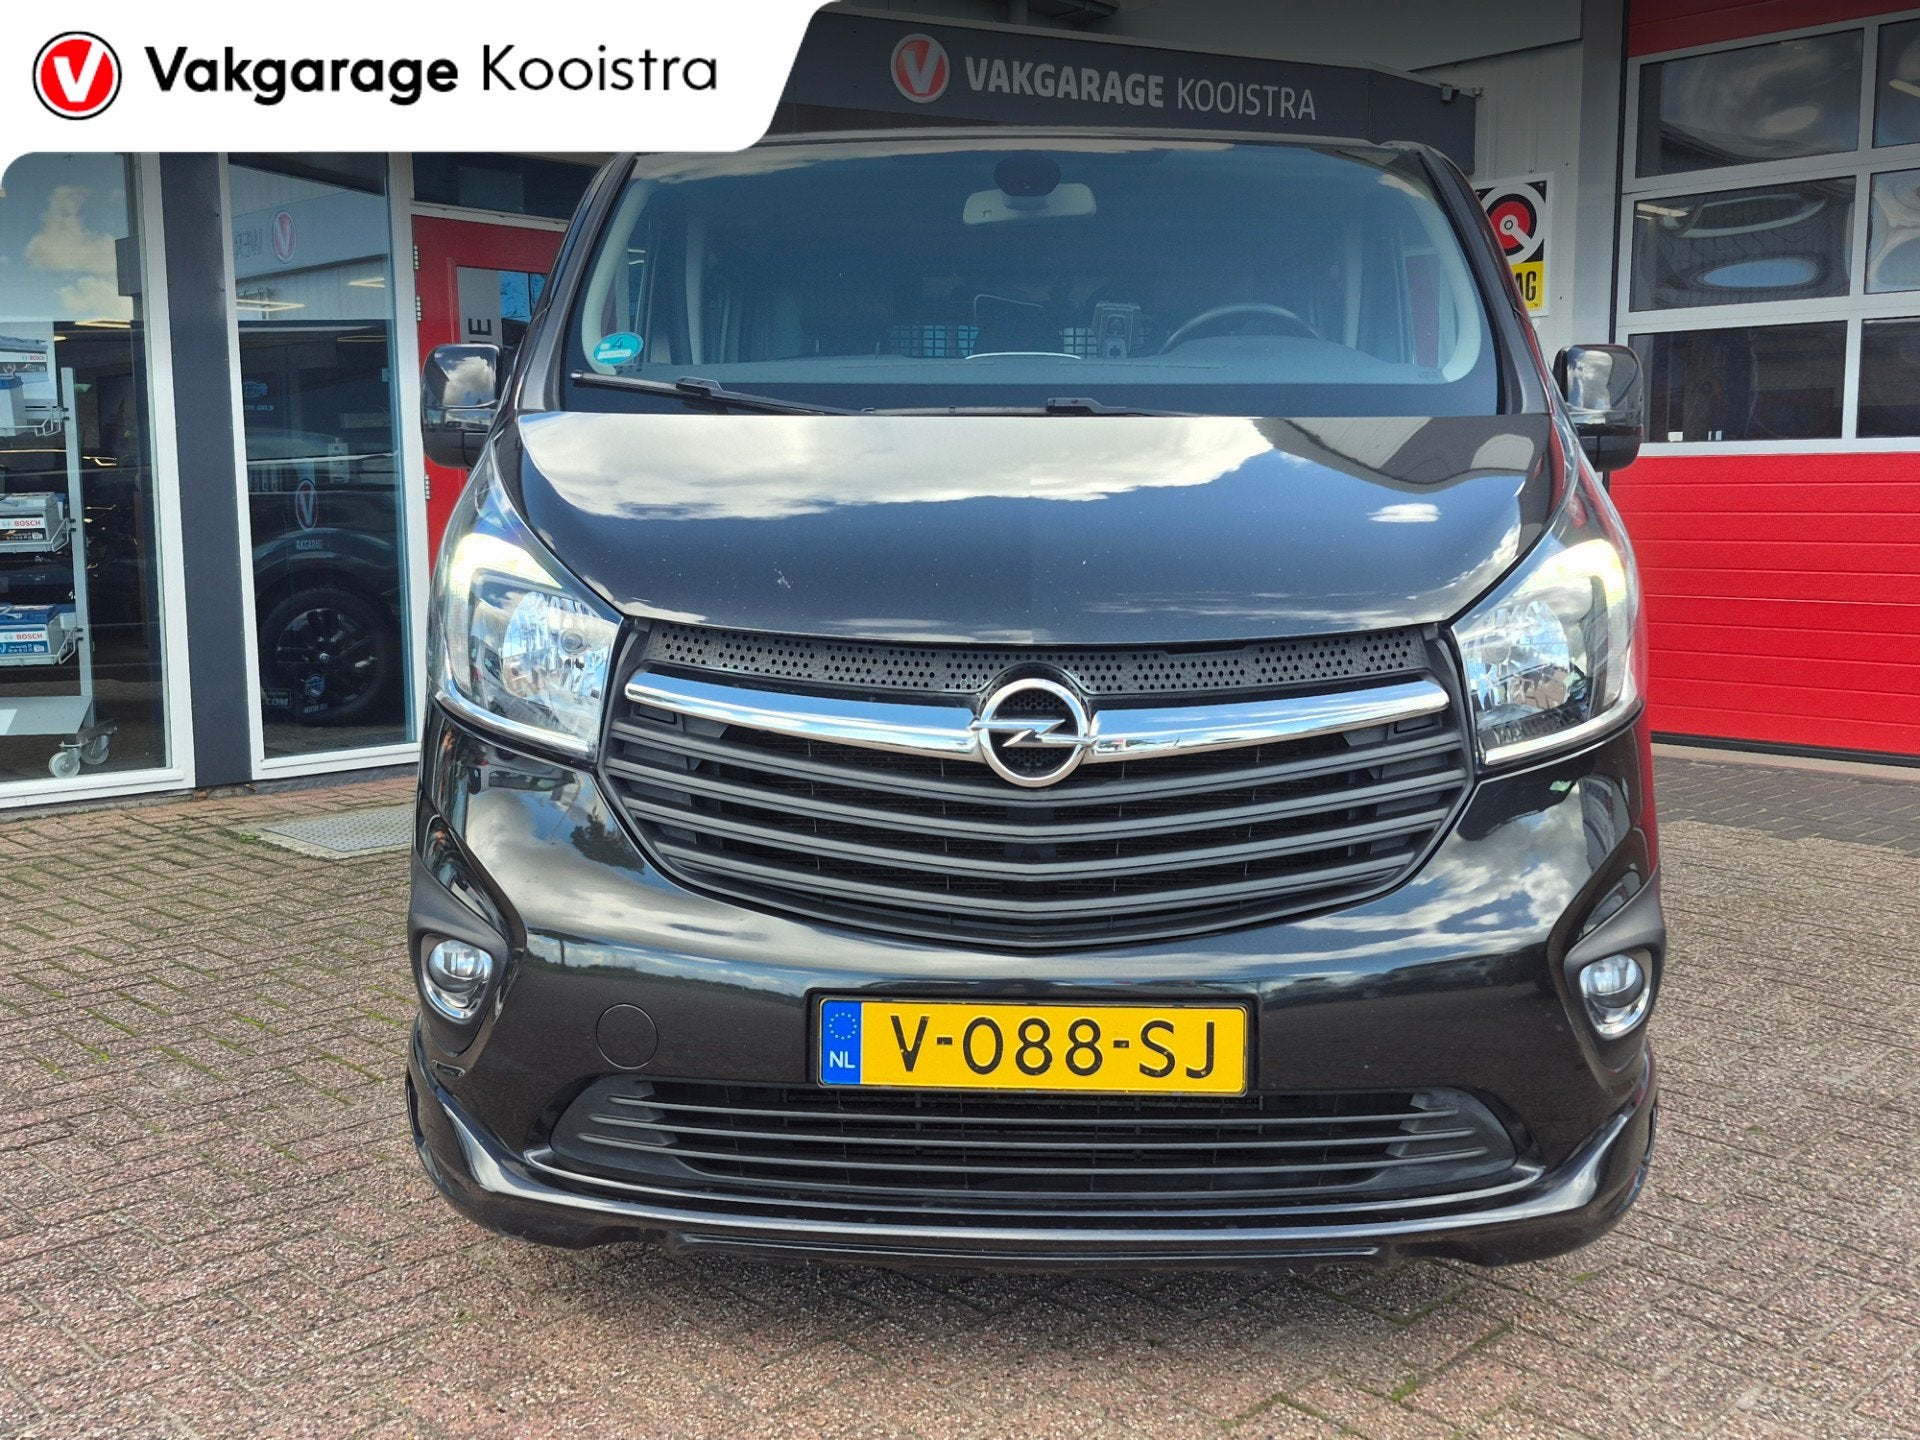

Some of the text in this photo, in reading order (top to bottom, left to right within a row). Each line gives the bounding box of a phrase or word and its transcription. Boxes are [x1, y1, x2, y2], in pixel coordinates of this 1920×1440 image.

[964, 56, 1317, 121] VAKGARAGE KOOISTRA
[829, 1051, 856, 1069] NL
[890, 1015, 1216, 1079] V-088-SJ
